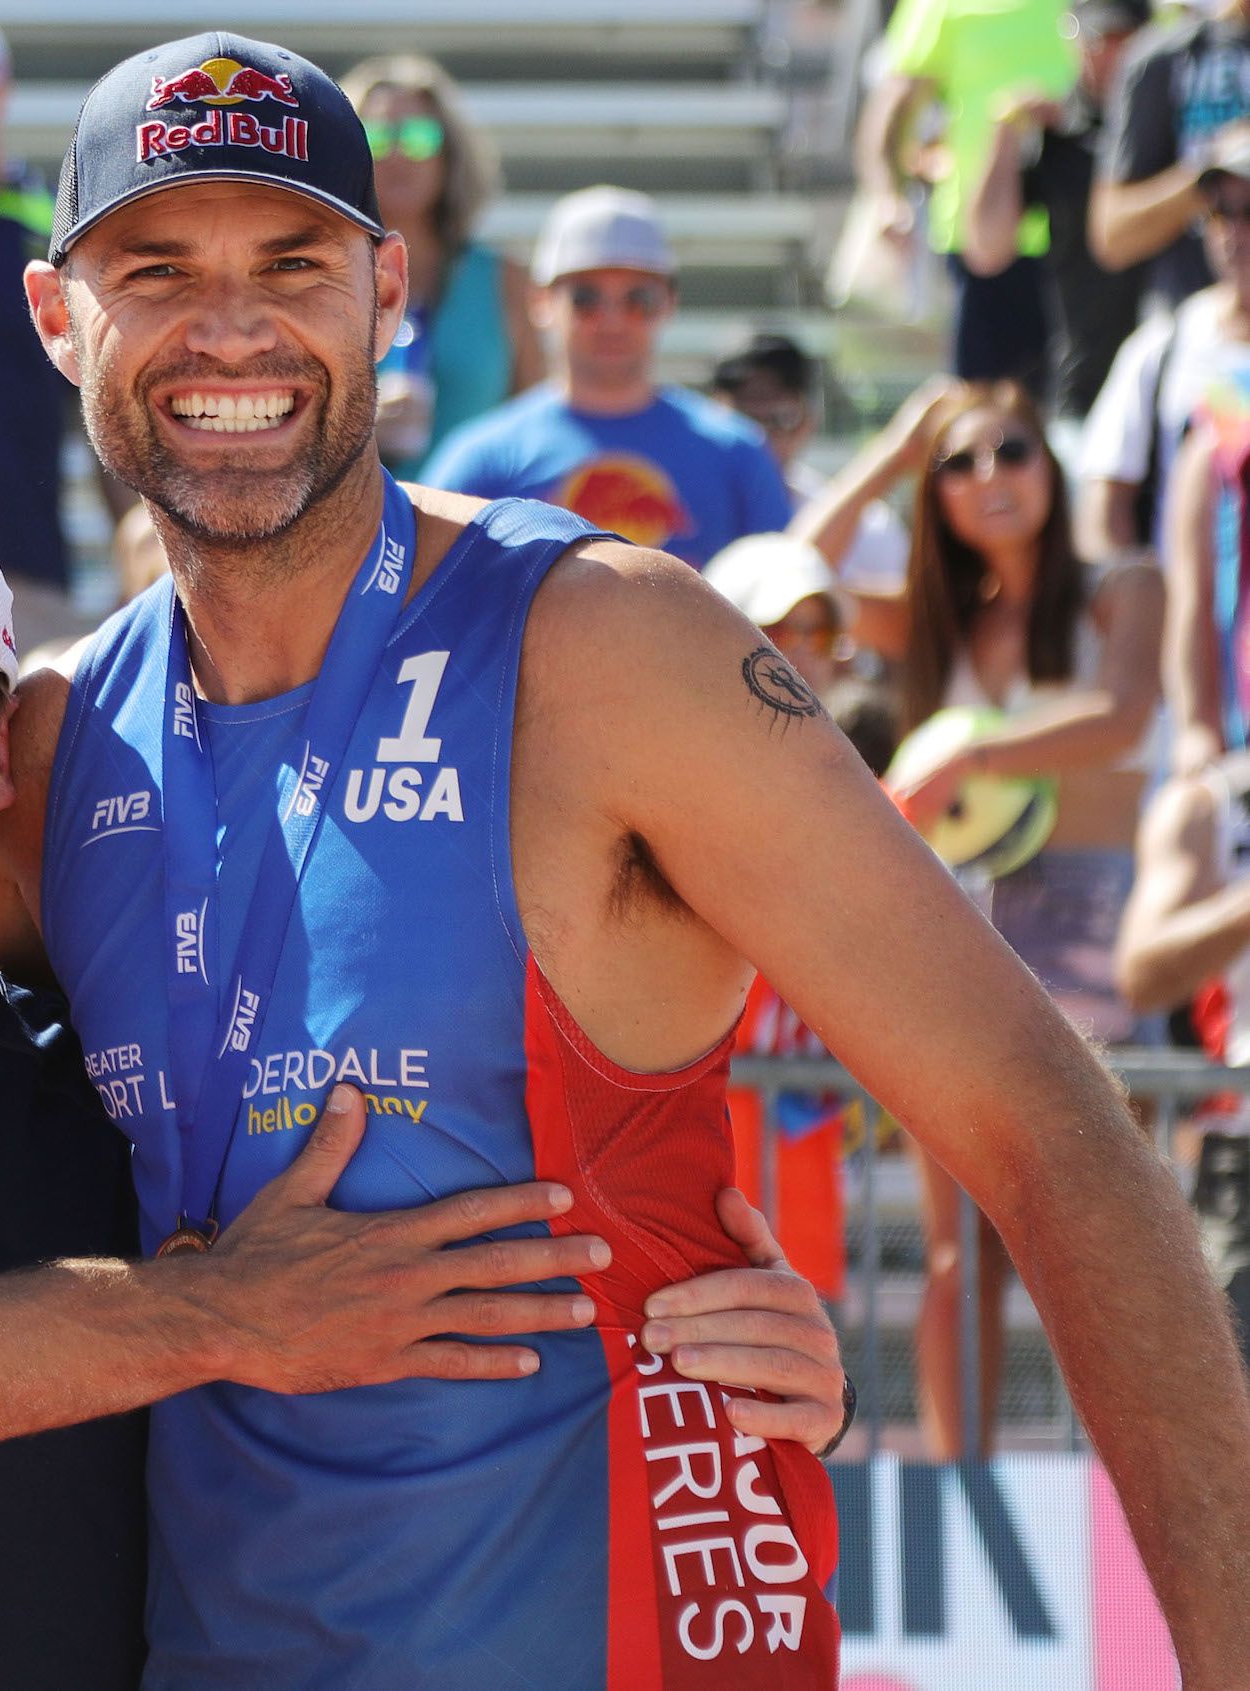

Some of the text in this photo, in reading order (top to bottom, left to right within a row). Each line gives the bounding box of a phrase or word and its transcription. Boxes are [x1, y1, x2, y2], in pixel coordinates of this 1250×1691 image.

[136, 110, 308, 163] Red Bull
[377, 537, 406, 594] FIVB
[174, 682, 194, 738] FIVB
[377, 651, 450, 763] 1
[92, 791, 151, 829] FIVB
[296, 756, 330, 817] FIVB
[344, 767, 464, 823] USA
[176, 912, 198, 974] FIVB
[231, 989, 260, 1053] FIVB
[85, 1043, 143, 1080] REATER
[95, 1074, 145, 1119] ORT
[249, 1094, 428, 1136] hello nny
